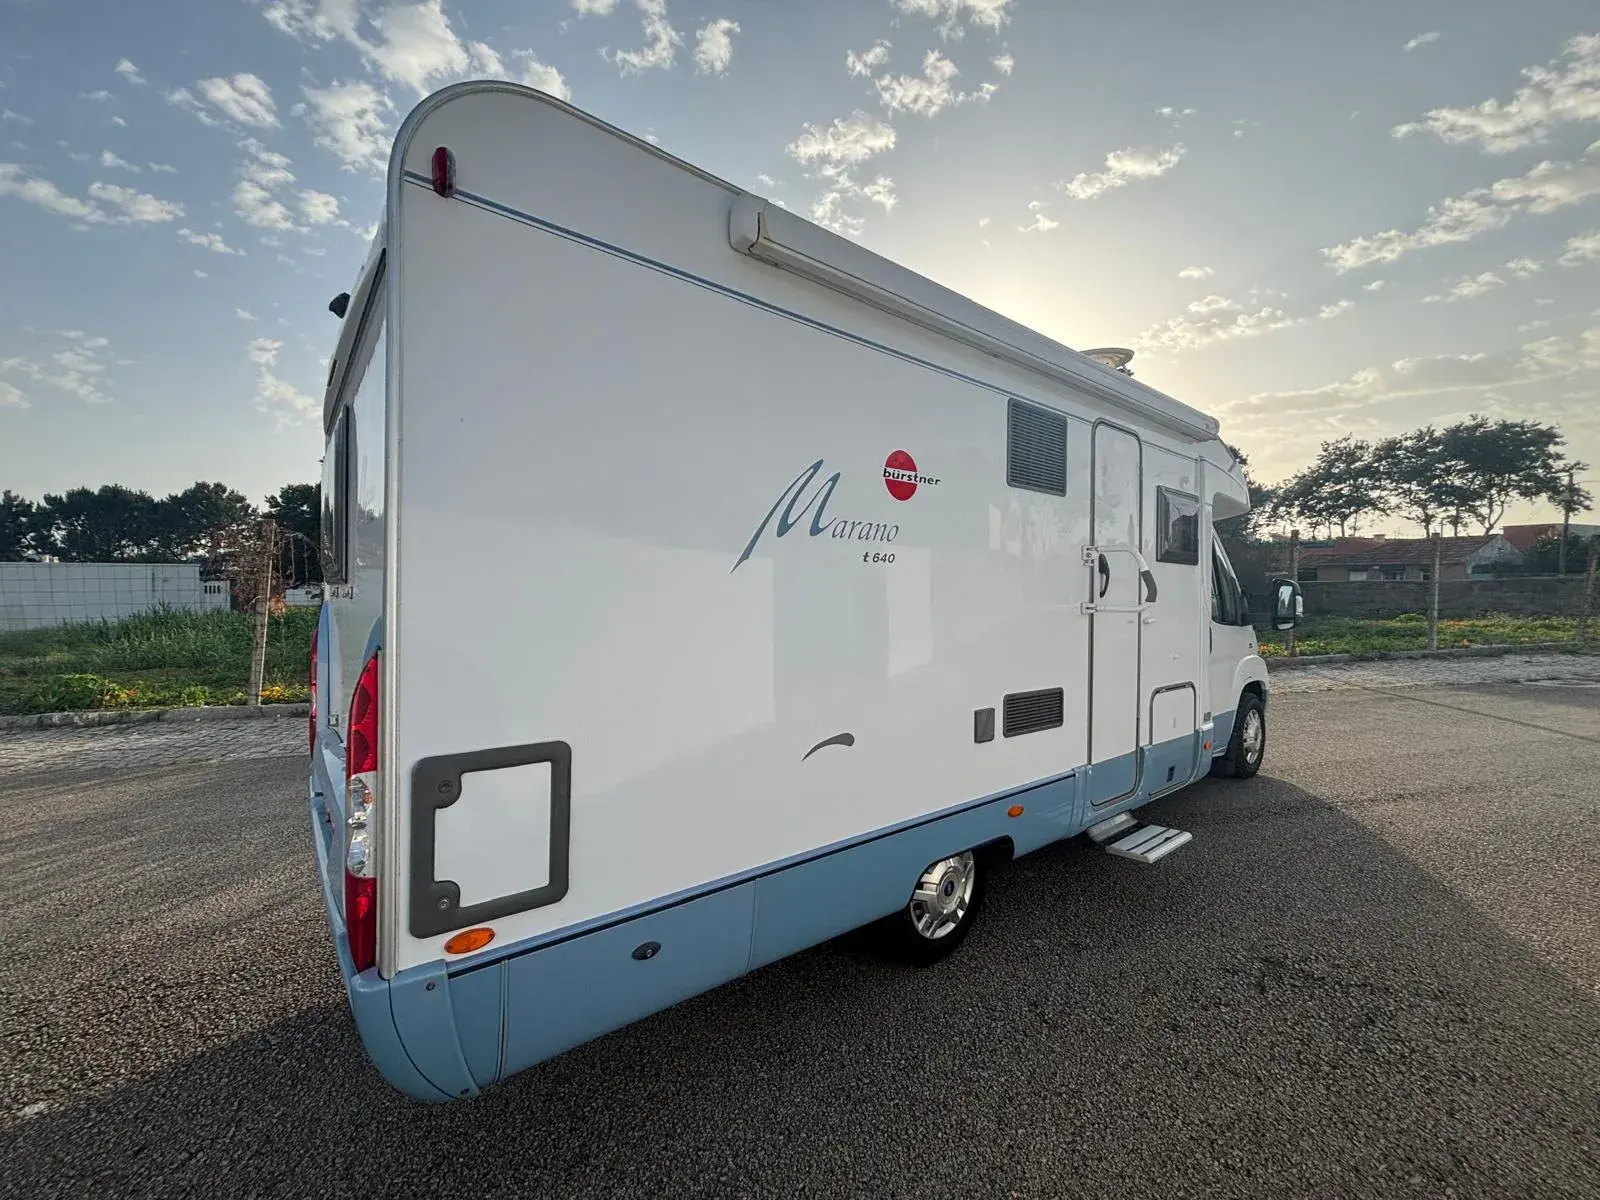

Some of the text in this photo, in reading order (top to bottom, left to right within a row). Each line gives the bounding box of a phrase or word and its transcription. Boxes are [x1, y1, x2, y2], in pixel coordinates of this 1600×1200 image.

[882, 467, 941, 486] bürstner
[729, 458, 900, 575] Marano
[862, 551, 896, 563] t 640
